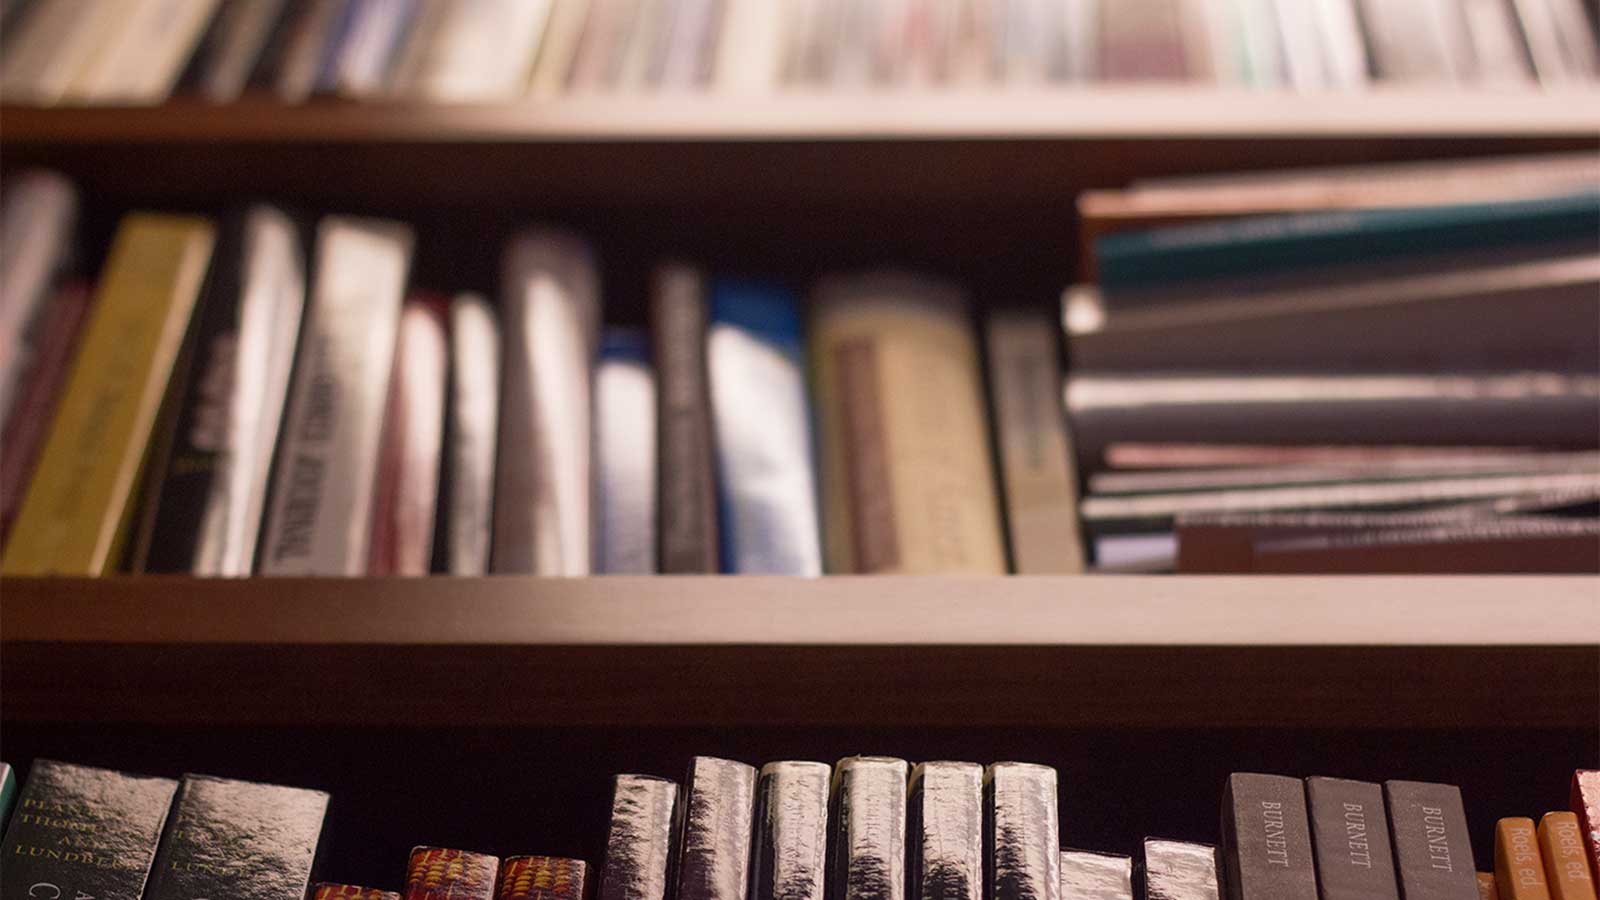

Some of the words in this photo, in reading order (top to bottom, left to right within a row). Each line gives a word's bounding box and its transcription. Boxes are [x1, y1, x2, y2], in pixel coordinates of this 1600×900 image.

[1262, 800, 1289, 867] BURNETT
[1343, 802, 1372, 868] BURNETT
[1422, 806, 1453, 872] BURNETT
[1510, 828, 1538, 865] Roels,
[1557, 821, 1584, 858] Roels,
[1518, 868, 1545, 889] ed.
[1566, 861, 1592, 882] ed.
